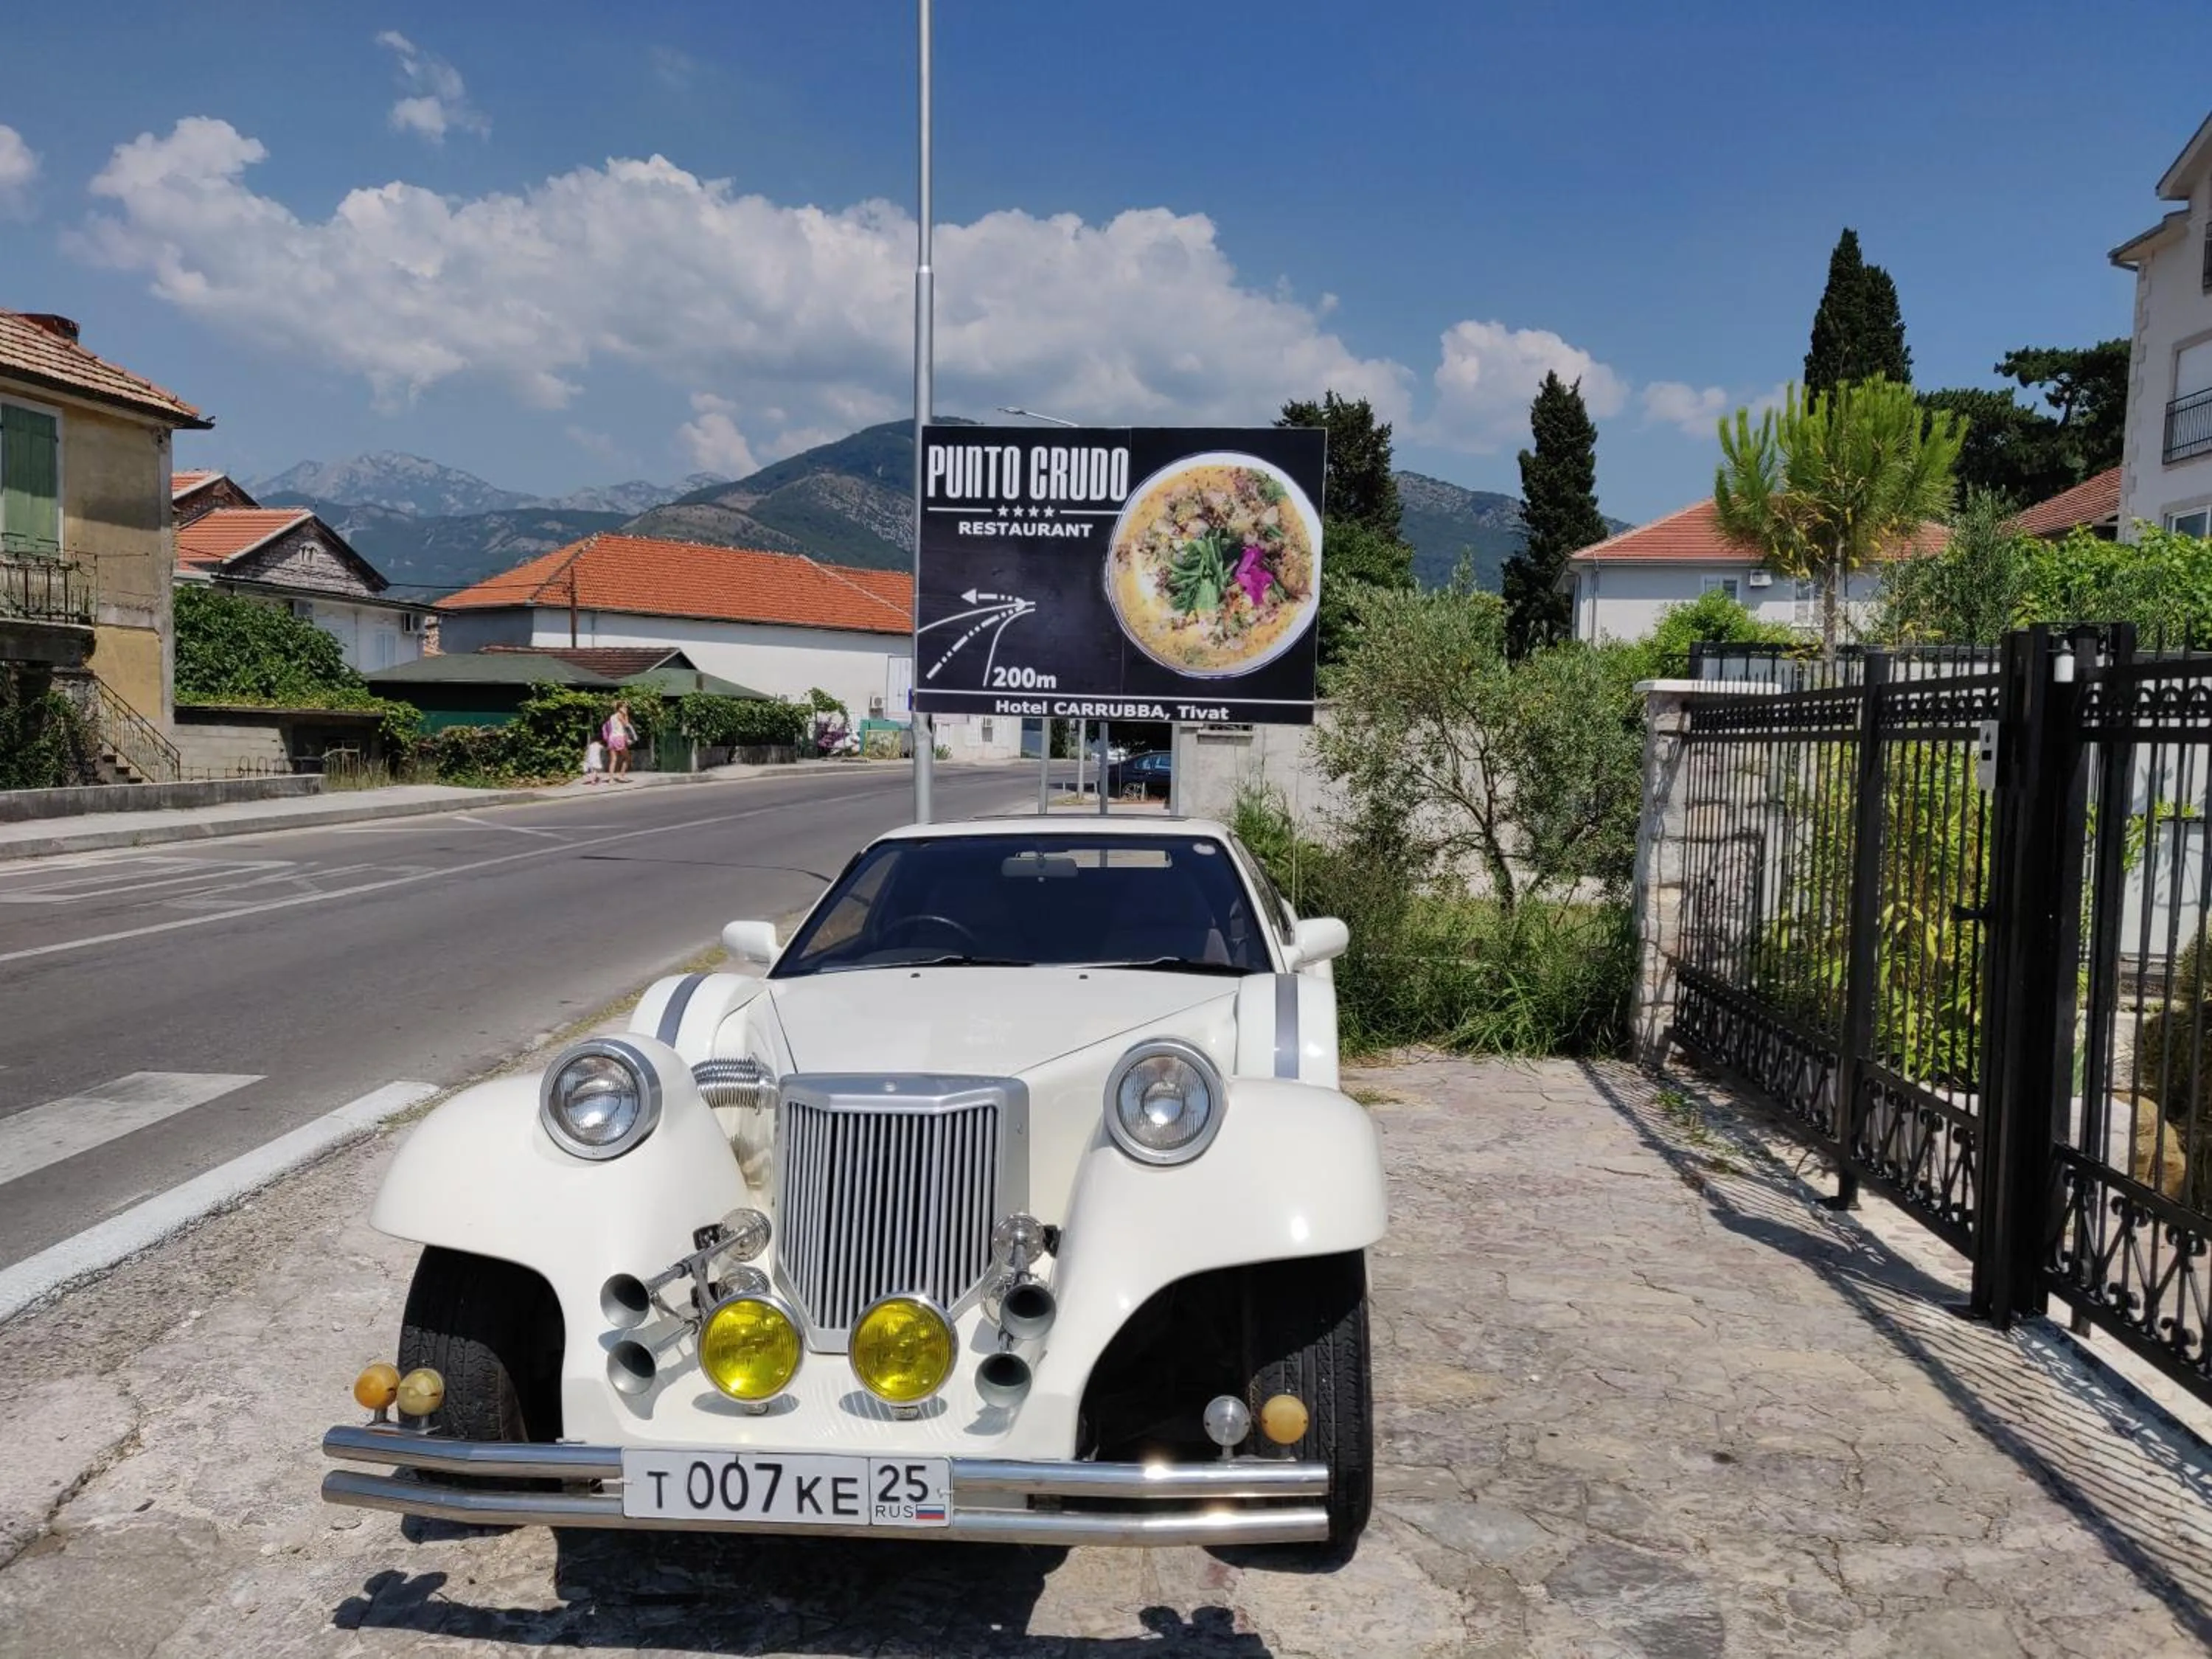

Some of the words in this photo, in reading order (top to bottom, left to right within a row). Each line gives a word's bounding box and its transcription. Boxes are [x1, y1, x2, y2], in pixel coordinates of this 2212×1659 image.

[927, 445, 1021, 498] PUNTO
[1029, 447, 1129, 501] CRUDO
[958, 521, 1093, 538] RESTAURANT
[992, 667, 1057, 688] 200m
[995, 700, 1048, 714] Hotel
[1054, 702, 1170, 720] CARRUBBA,
[1177, 705, 1230, 720] Tivat
[877, 1464, 929, 1503] 25
[874, 1504, 914, 1519] RUS
